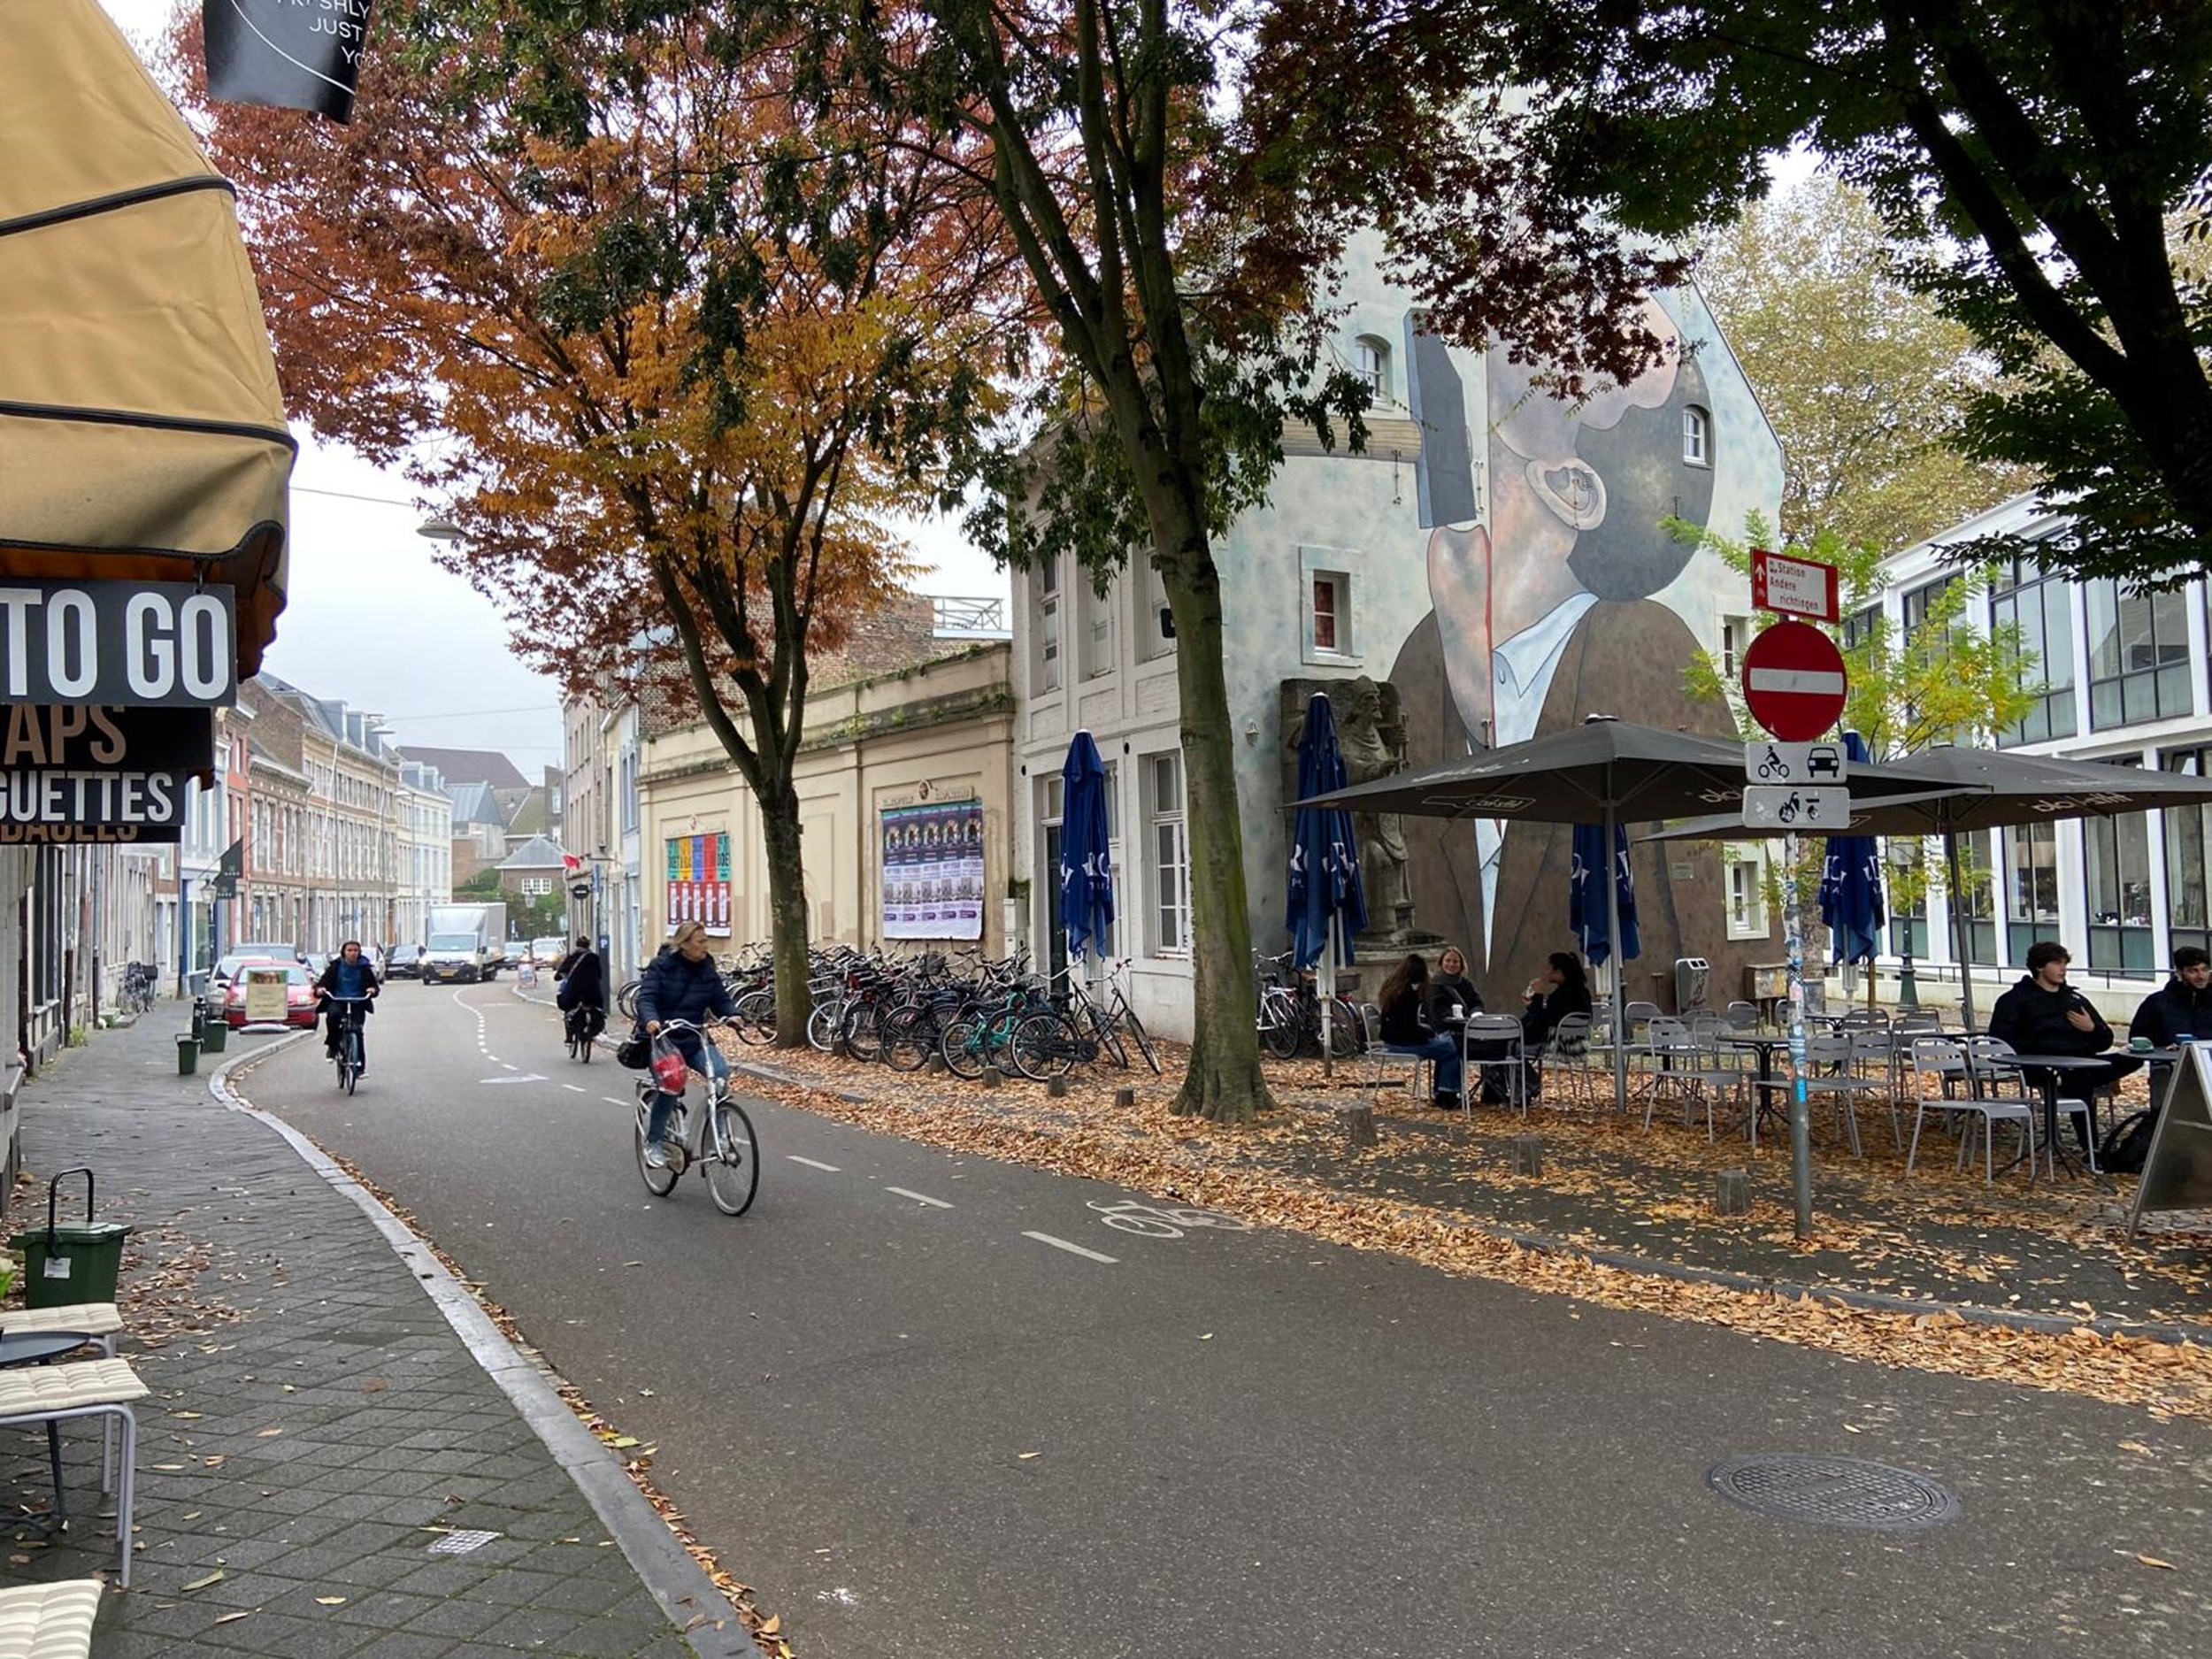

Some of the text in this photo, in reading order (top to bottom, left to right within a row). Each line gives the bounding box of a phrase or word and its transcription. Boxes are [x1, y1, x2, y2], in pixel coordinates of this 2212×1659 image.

[309, 17, 364, 42] JUST
[1778, 561, 1806, 578] Station
[1770, 576, 1797, 592] Andere
[1779, 594, 1819, 611] richtingen
[0, 588, 229, 700] TO GO
[0, 771, 173, 822] UETTES
